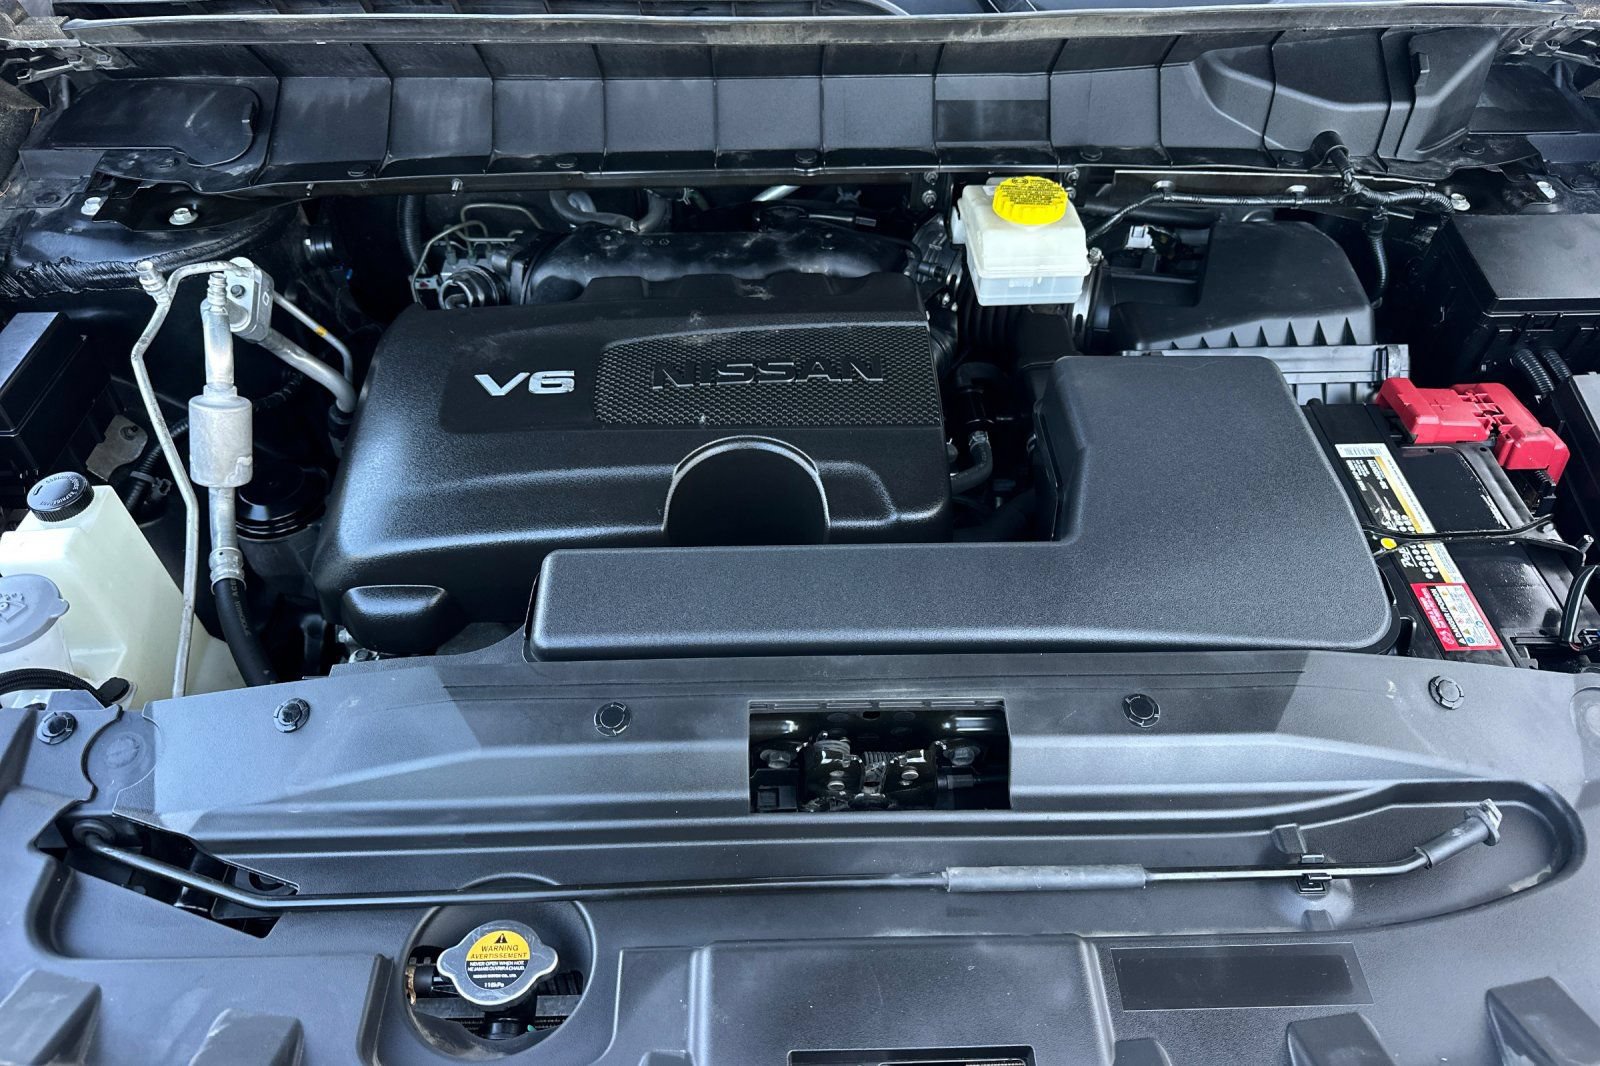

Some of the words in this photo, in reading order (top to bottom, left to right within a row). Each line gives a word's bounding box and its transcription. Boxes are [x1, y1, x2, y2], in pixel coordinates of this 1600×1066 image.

[651, 356, 885, 390] NISSAN
[474, 370, 576, 396] V6
[470, 952, 528, 960] AVERTISSEMENT
[481, 944, 519, 952] WARNING
